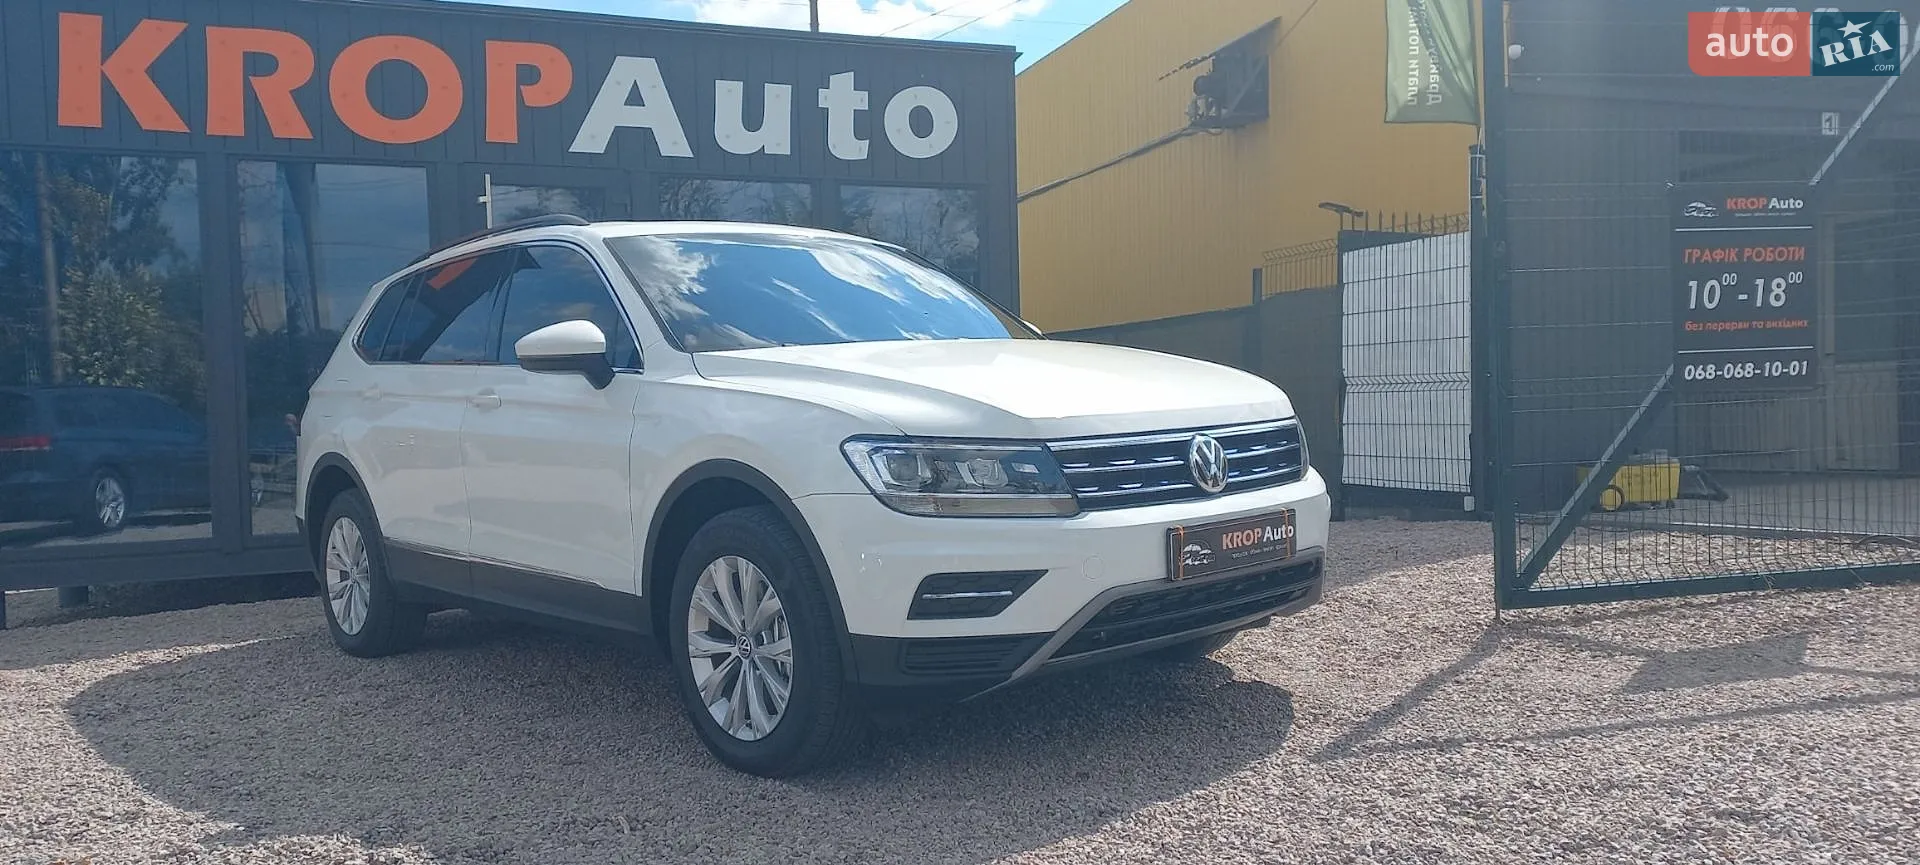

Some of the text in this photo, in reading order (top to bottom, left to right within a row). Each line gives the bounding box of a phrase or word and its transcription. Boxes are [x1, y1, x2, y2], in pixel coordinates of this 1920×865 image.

[1683, 246, 1805, 264] ГРАФІК РОБОТИ
[1685, 321, 1703, 331] без
[1752, 321, 1764, 329] та
[1765, 318, 1809, 330] вихідних
[1684, 360, 1809, 381] 068-068-10-01
